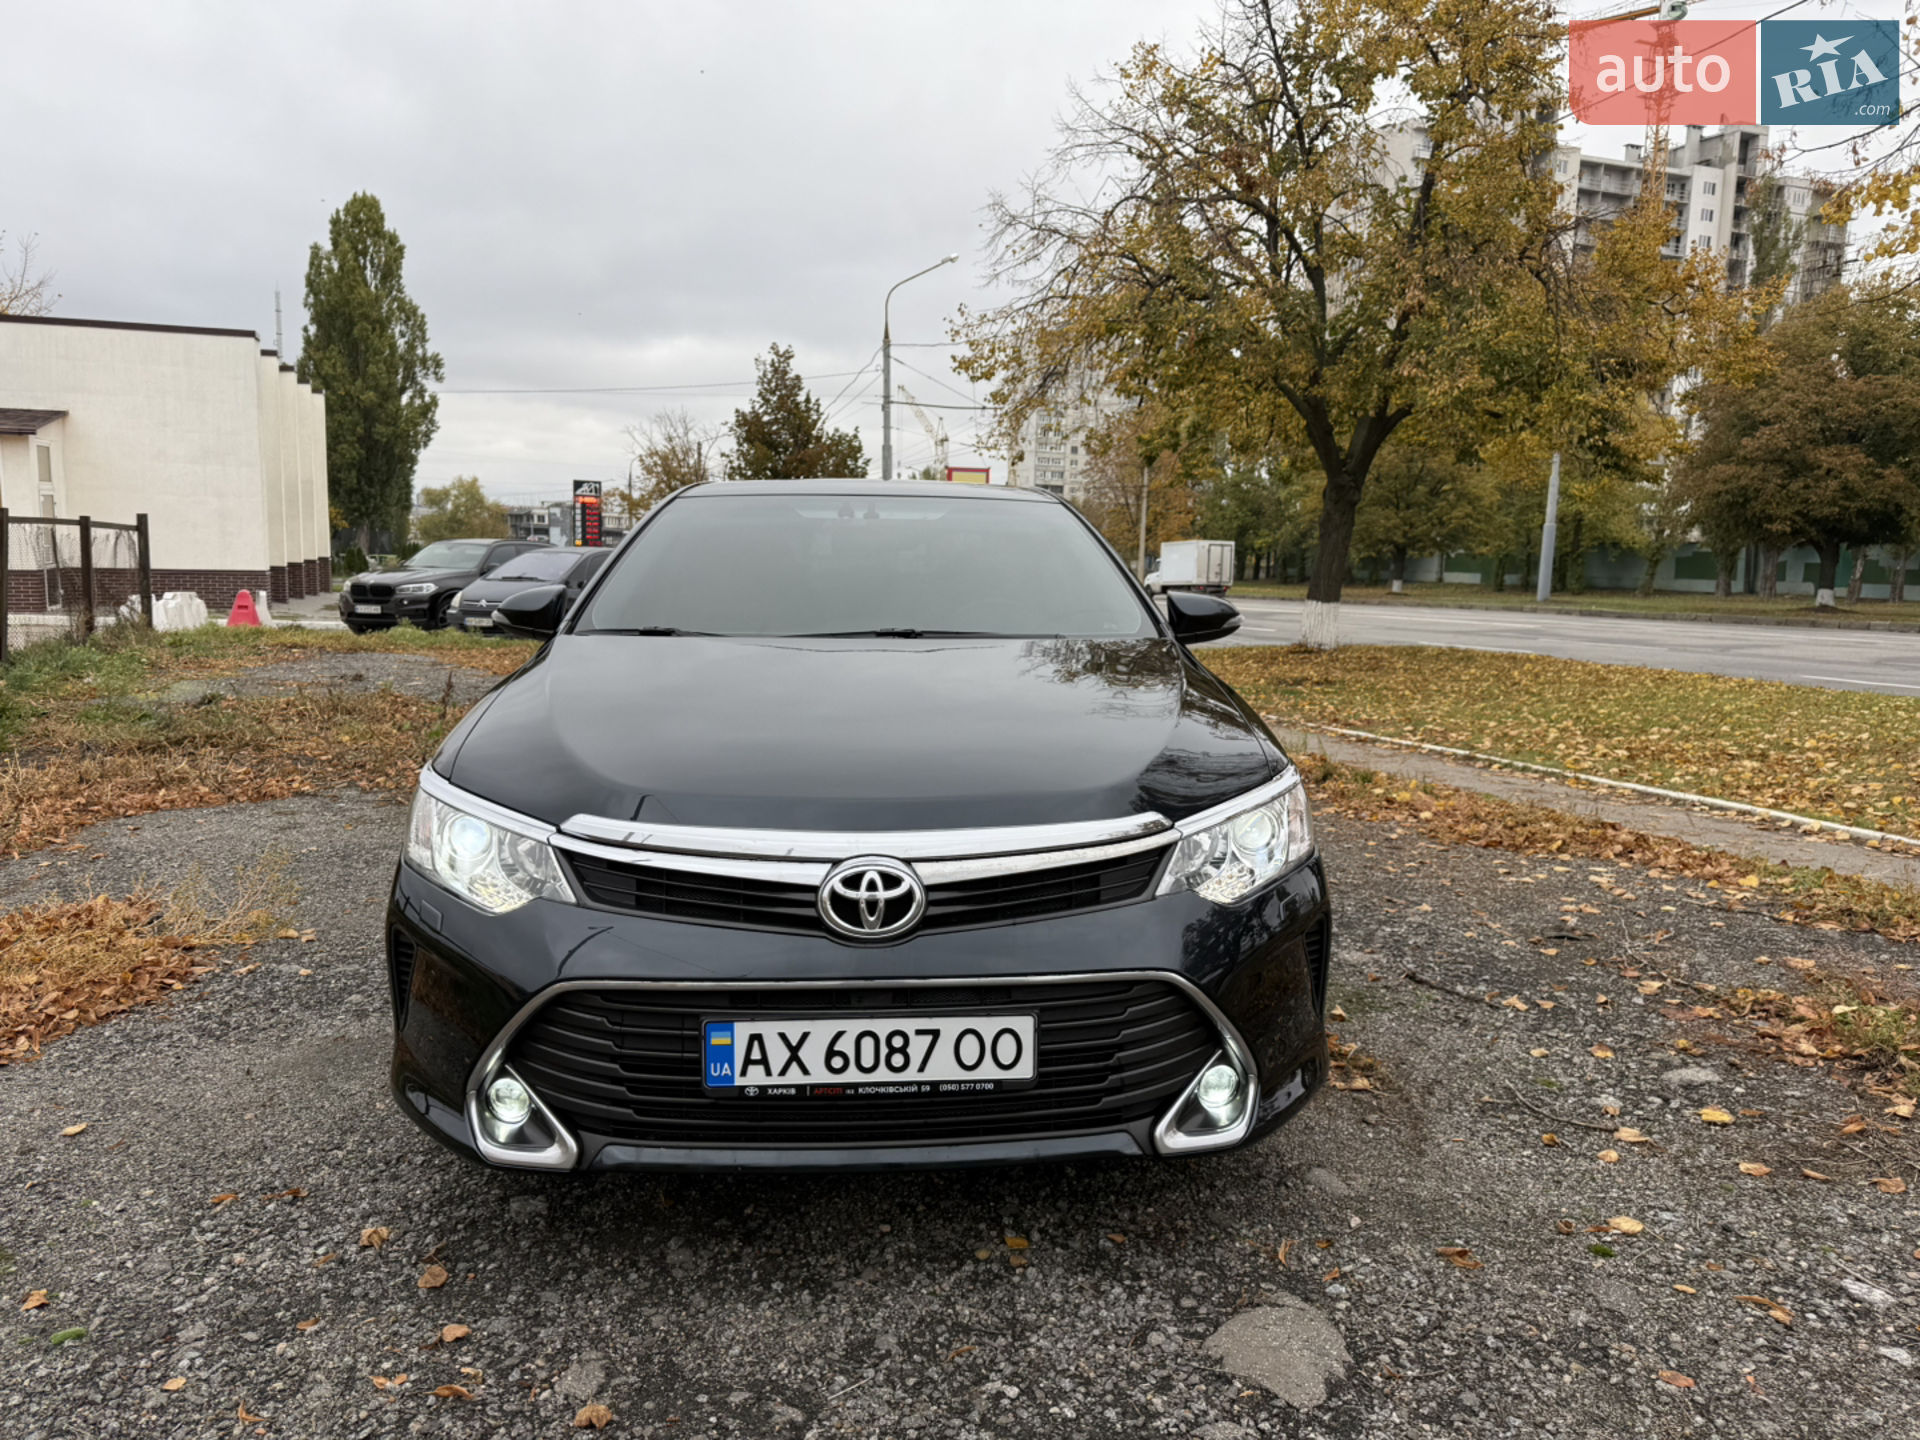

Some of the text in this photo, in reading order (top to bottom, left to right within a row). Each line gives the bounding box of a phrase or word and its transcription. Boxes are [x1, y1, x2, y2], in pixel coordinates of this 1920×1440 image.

[739, 1031, 811, 1077] AX
[824, 1028, 941, 1075] 6087
[710, 1062, 732, 1077] UA
[766, 1087, 797, 1095] ХАРКІВ
